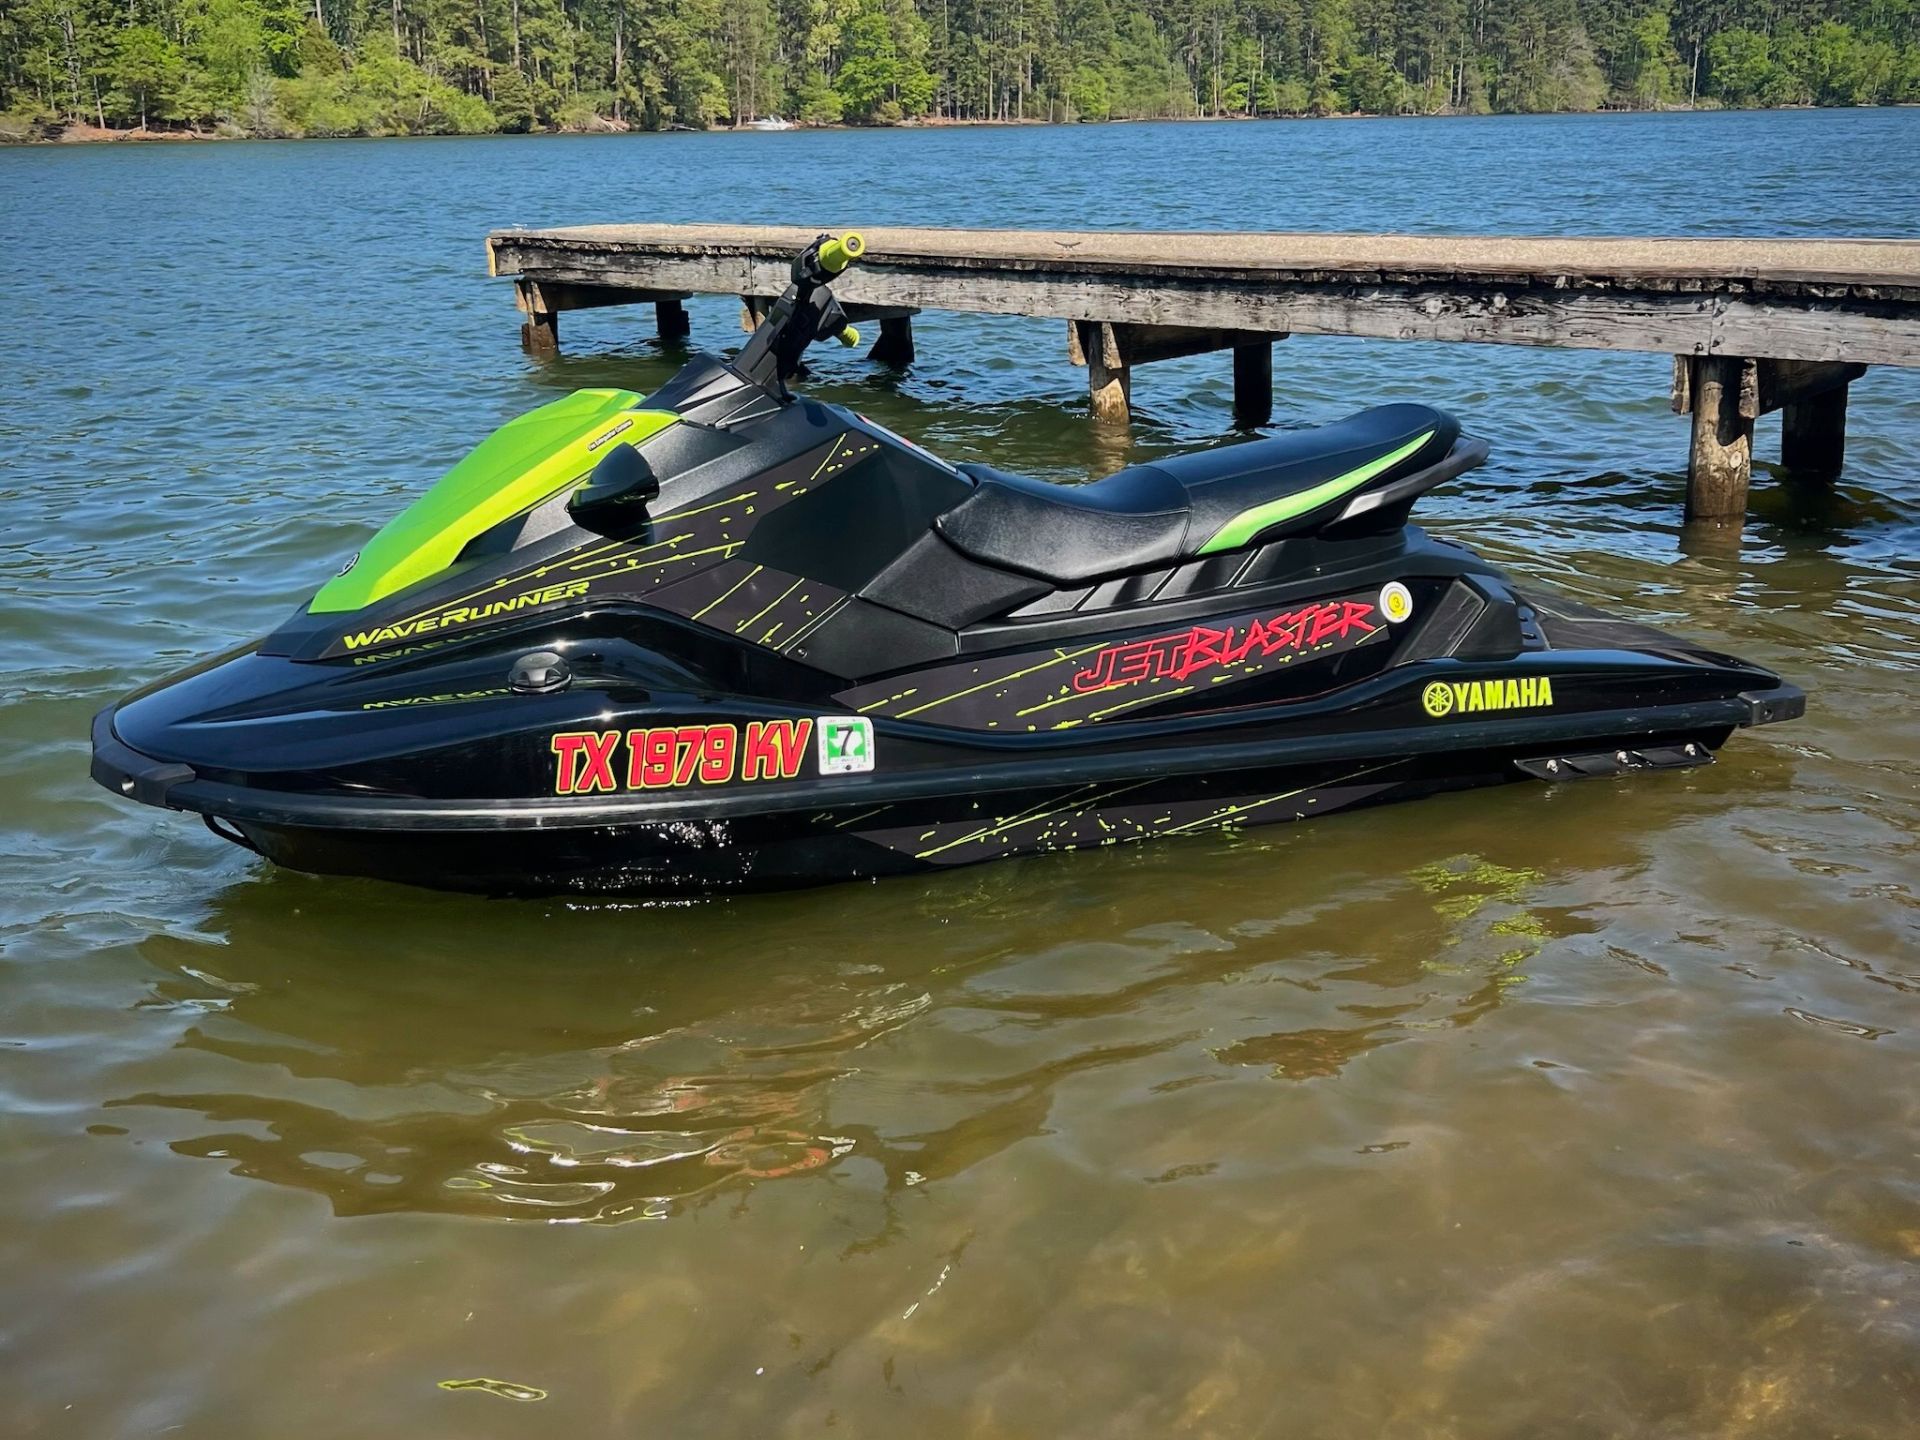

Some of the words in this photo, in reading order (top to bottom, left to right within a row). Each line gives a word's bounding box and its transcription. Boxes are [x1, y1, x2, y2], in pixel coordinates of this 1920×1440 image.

[343, 581, 590, 650] WAVERUNNER
[1073, 602, 1376, 692] JETBLASTER
[1453, 677, 1553, 713] YAMAHA
[552, 730, 621, 794] TX
[626, 723, 737, 791] 1979
[741, 718, 813, 782] KV
[836, 726, 854, 756] 7
